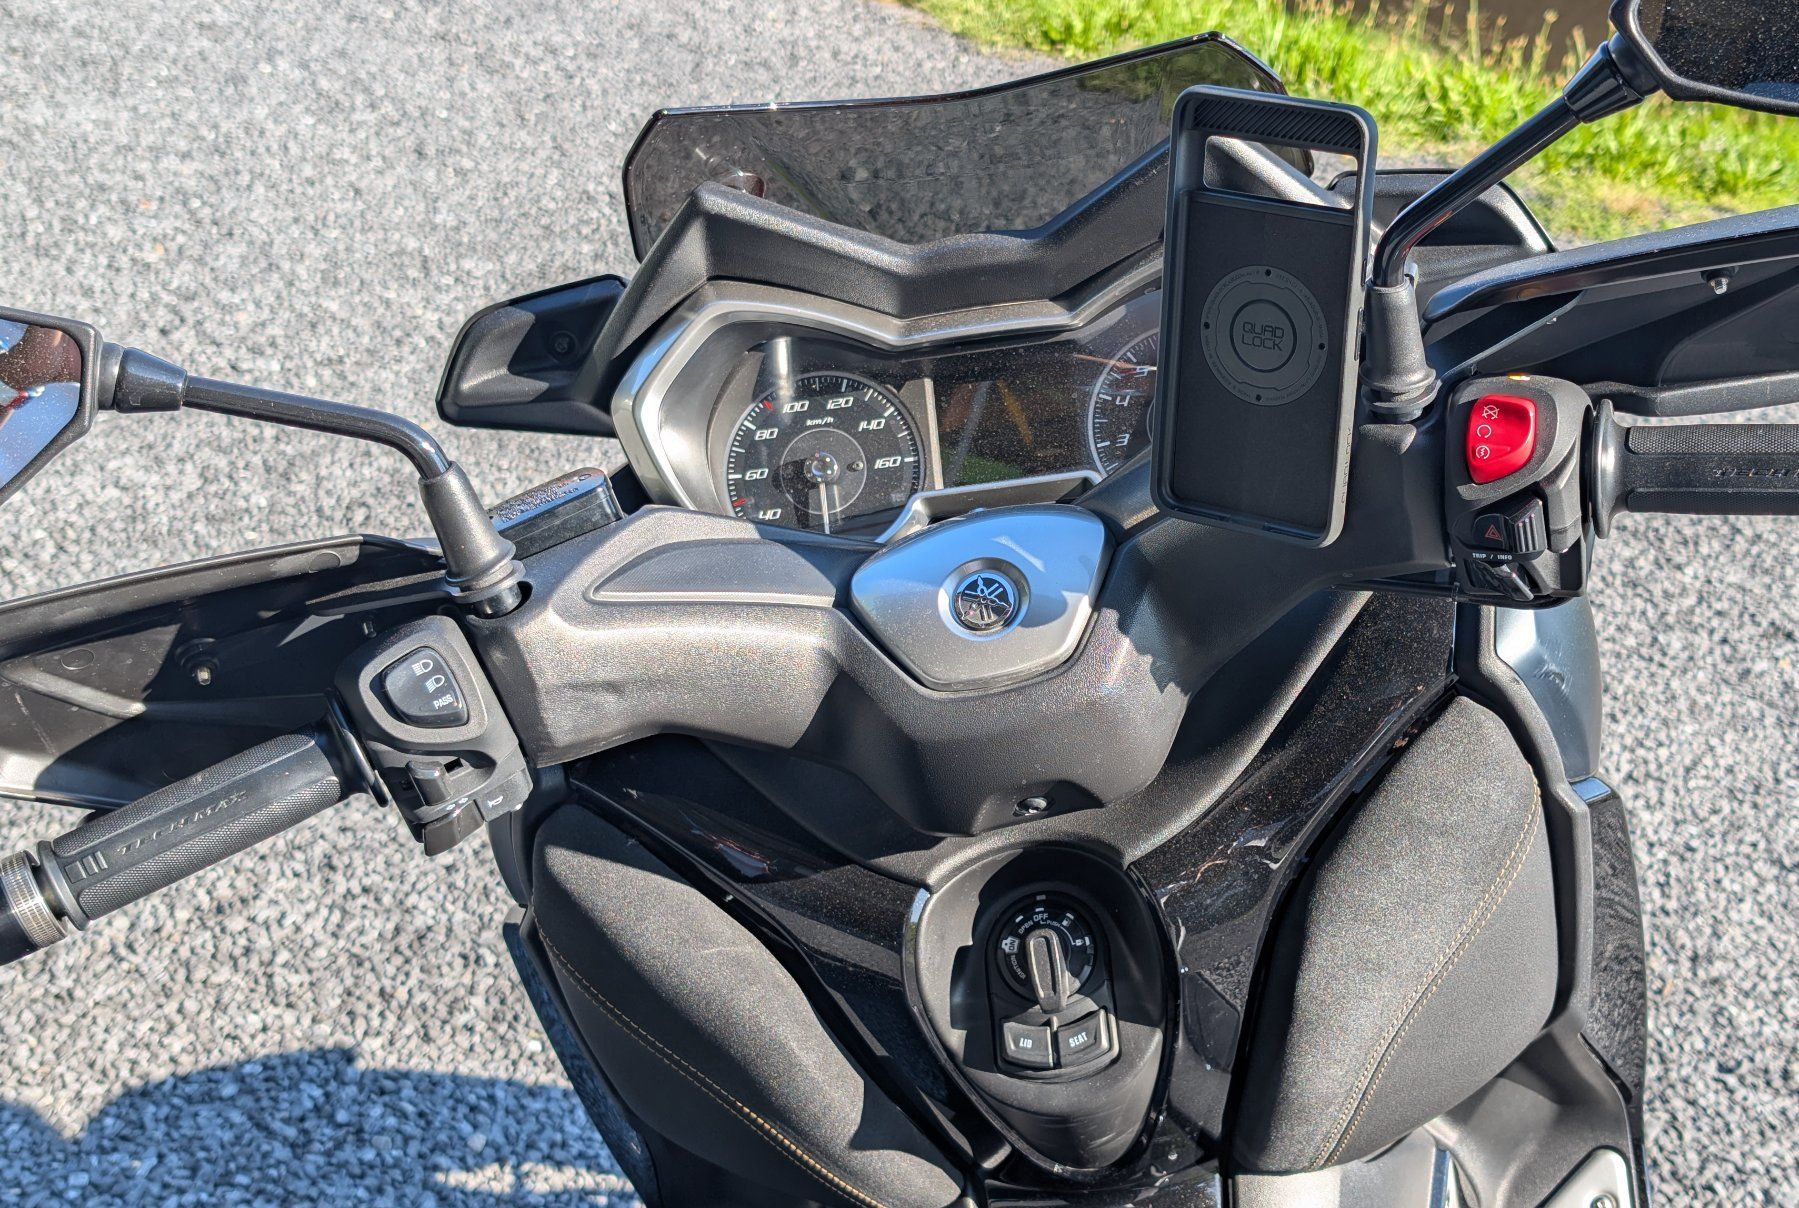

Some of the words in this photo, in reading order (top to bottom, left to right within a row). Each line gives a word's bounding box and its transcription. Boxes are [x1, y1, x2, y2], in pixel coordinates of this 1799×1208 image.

[1242, 321, 1285, 339] QUAD
[1241, 333, 1283, 351] LOCK
[782, 400, 809, 413] 100
[826, 396, 854, 410] 120
[1115, 394, 1131, 407] 4
[806, 416, 834, 426] km/h
[858, 418, 886, 432] 140
[754, 427, 779, 441] 80
[1115, 433, 1131, 447] 3
[874, 456, 901, 470] 160
[744, 468, 769, 481] 60
[758, 508, 782, 521] 40
[433, 694, 454, 710] PASS
[1033, 913, 1049, 922] OFF
[1019, 919, 1034, 935] OPEN
[1008, 939, 1016, 951] ON
[1010, 954, 1026, 980] IGNITION
[1019, 1037, 1033, 1049] LID
[1068, 1031, 1088, 1048] SEAT
